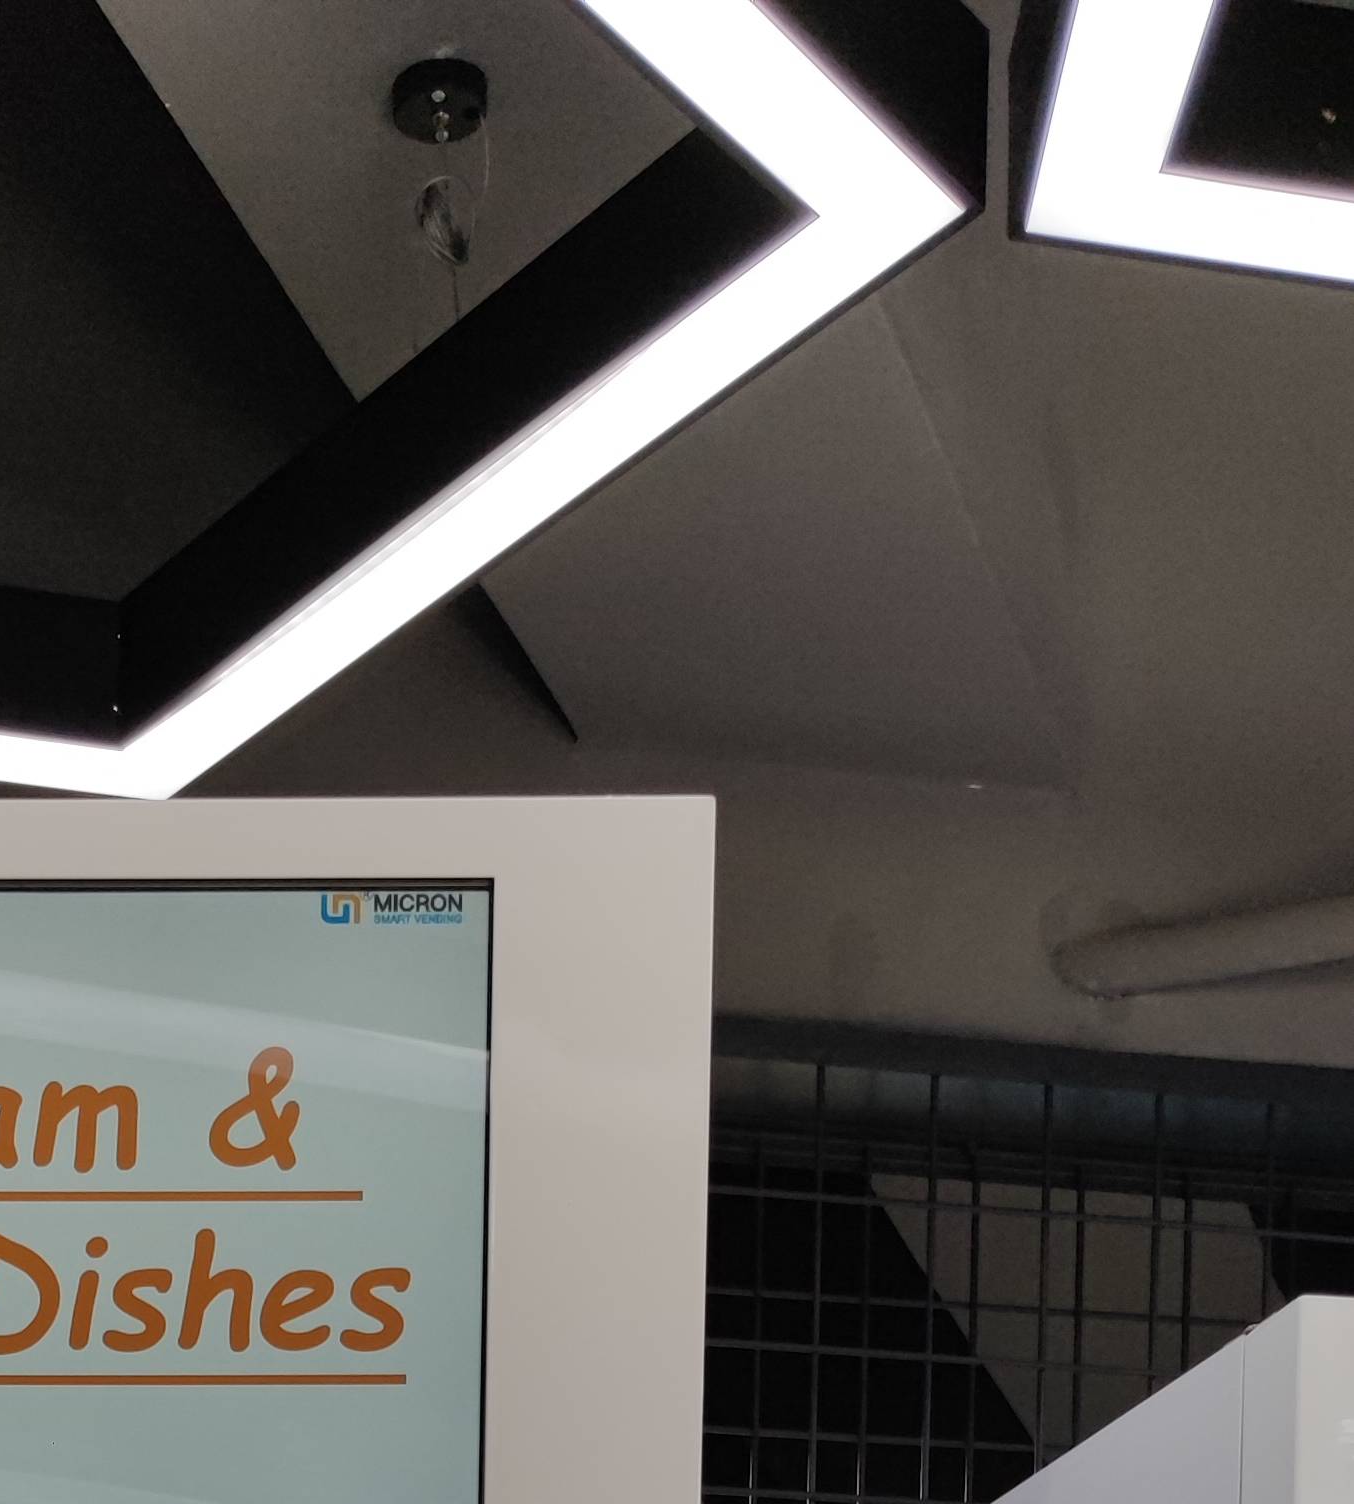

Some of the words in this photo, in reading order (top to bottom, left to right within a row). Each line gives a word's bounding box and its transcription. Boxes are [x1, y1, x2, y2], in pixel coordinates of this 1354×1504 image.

[374, 893, 463, 912] MICRON
[374, 914, 410, 924] SMART
[414, 914, 463, 924] VENDING
[209, 1046, 300, 1171] &
